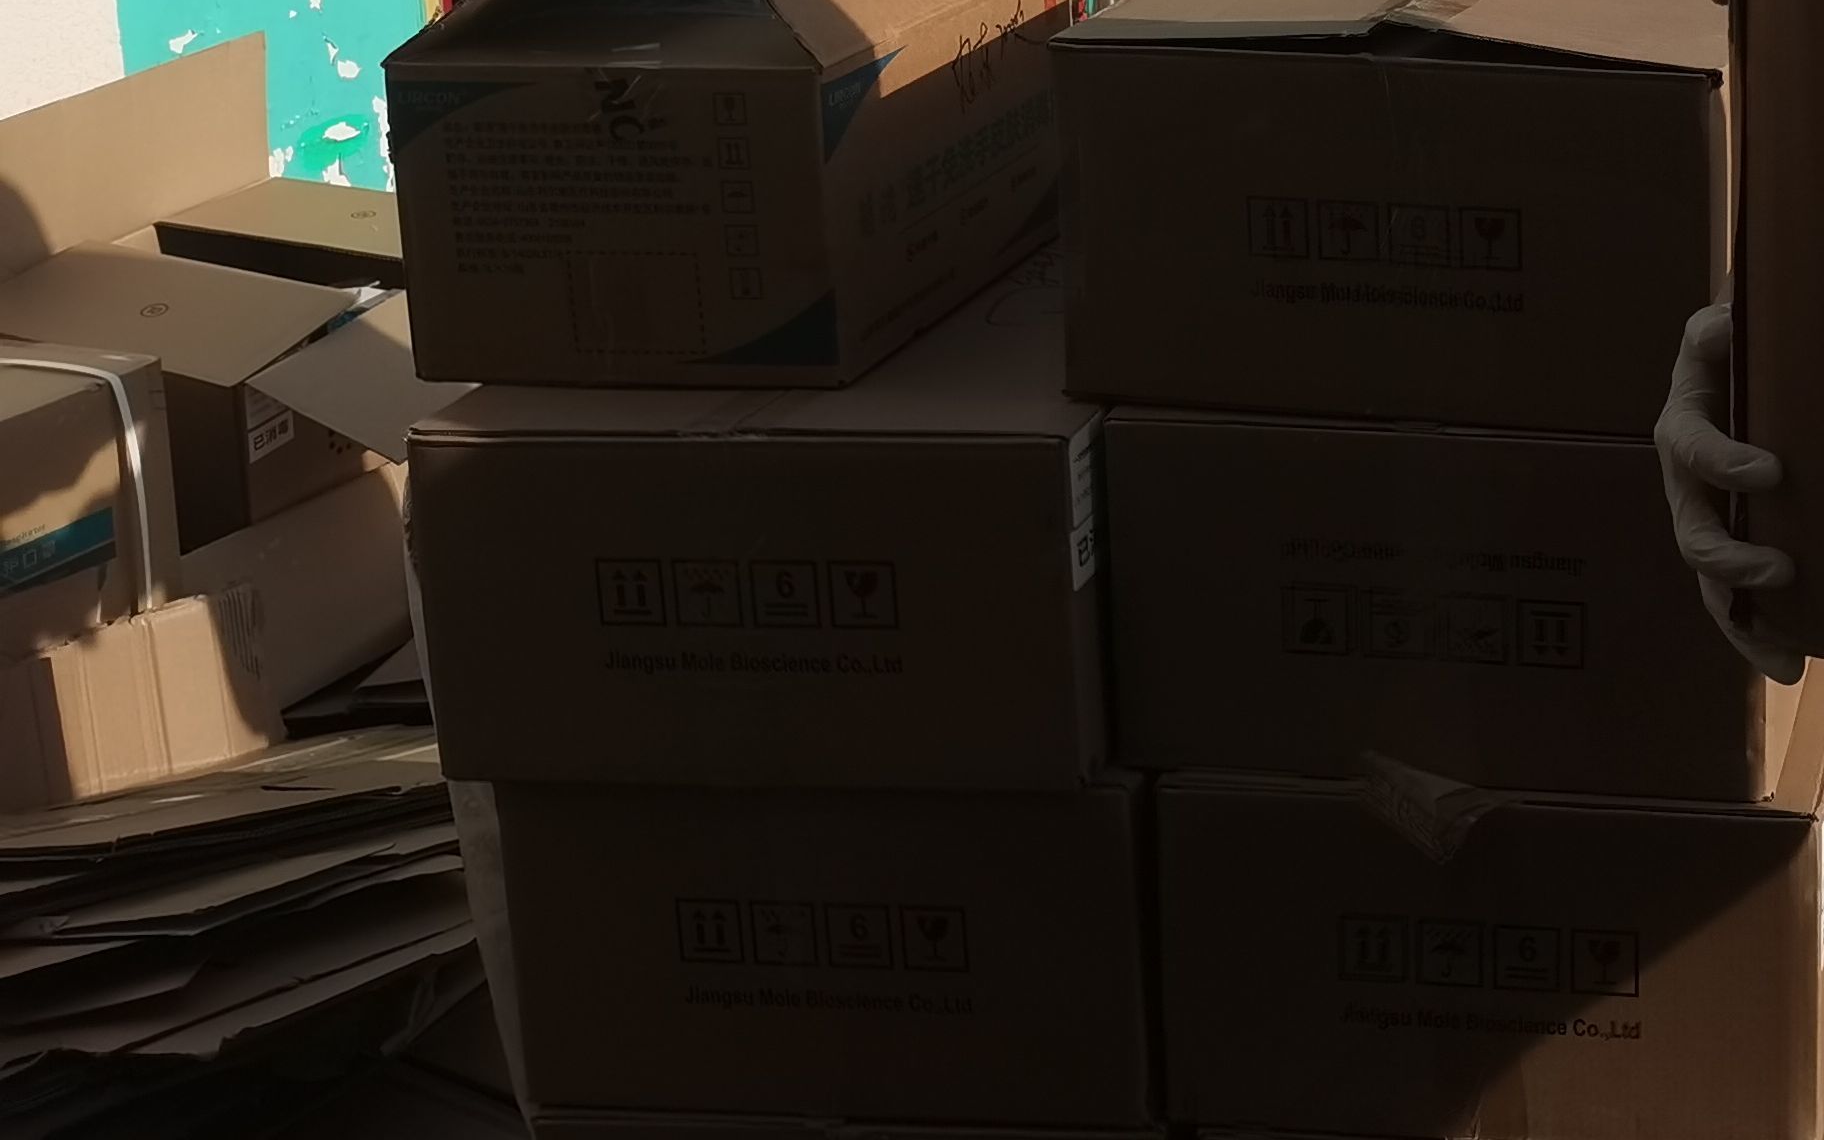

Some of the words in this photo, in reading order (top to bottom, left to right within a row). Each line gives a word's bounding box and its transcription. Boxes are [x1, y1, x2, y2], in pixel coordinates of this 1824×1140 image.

[253, 419, 290, 451] 已消毒
[604, 649, 678, 676] Jiangsu
[681, 650, 726, 674] Mole
[730, 651, 832, 675] Bioscience
[684, 984, 755, 1011] Jiangsu
[758, 987, 801, 1009] Mole
[806, 988, 904, 1012] Bioscience
